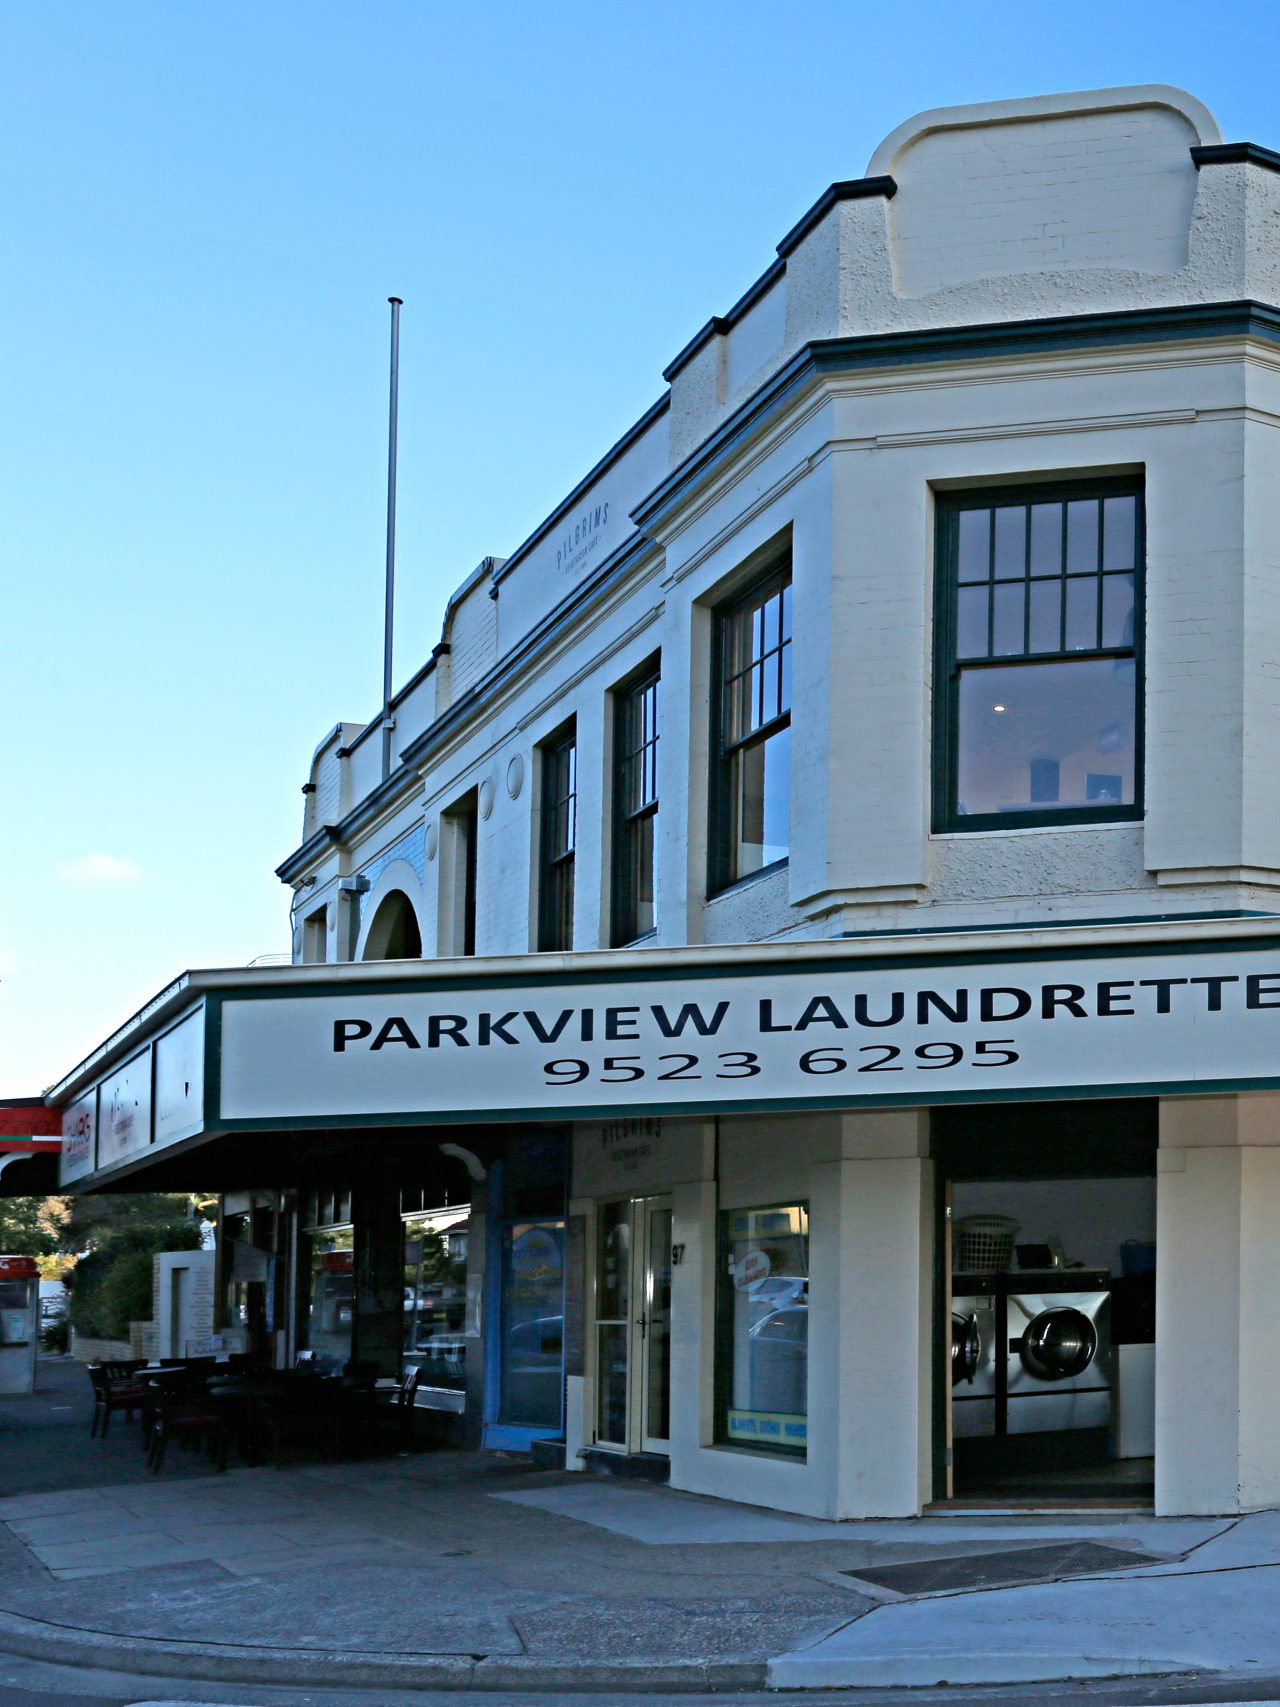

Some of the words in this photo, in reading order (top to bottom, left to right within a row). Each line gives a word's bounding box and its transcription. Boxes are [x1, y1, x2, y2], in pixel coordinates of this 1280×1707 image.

[556, 502, 609, 570] PILGRIMS
[333, 1001, 731, 1053] PARKVIEW
[543, 1052, 762, 1086] 9523
[799, 1039, 1020, 1075] 6295
[672, 1244, 686, 1265] 97
